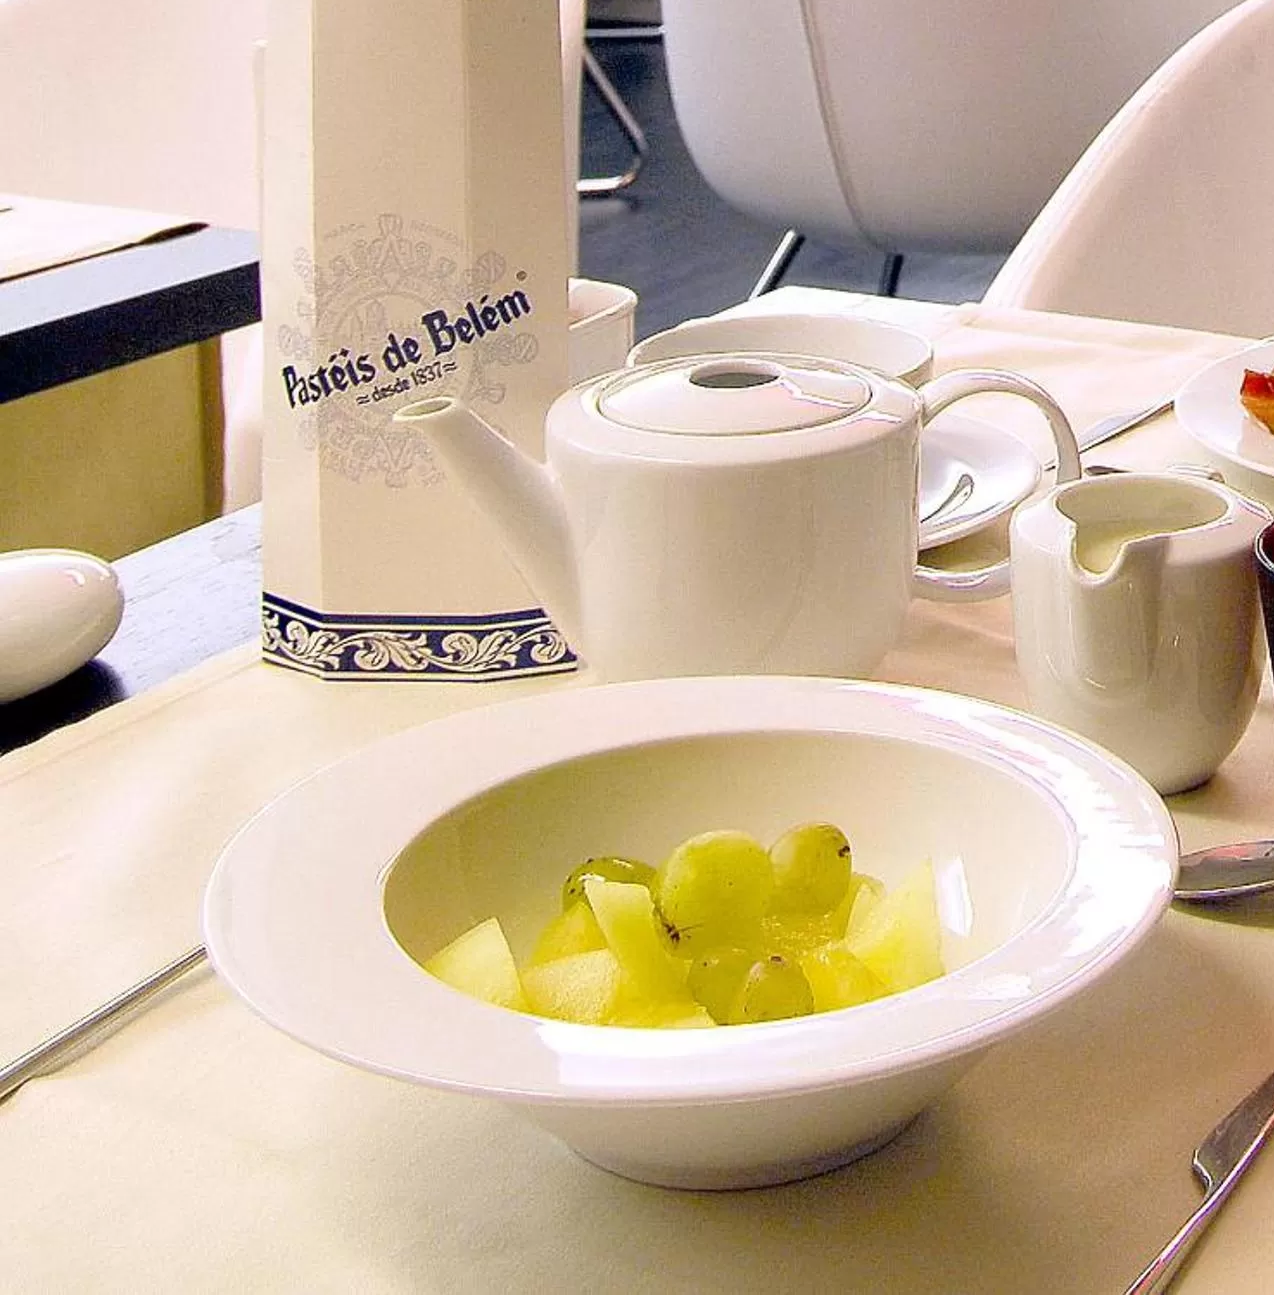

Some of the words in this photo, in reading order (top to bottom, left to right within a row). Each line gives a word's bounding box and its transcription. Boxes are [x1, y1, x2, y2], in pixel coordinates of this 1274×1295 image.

[281, 348, 376, 409] Pastéis
[382, 333, 422, 373] de
[421, 290, 531, 356] Belém
[372, 378, 411, 401] desde
[410, 361, 442, 385] 1837
